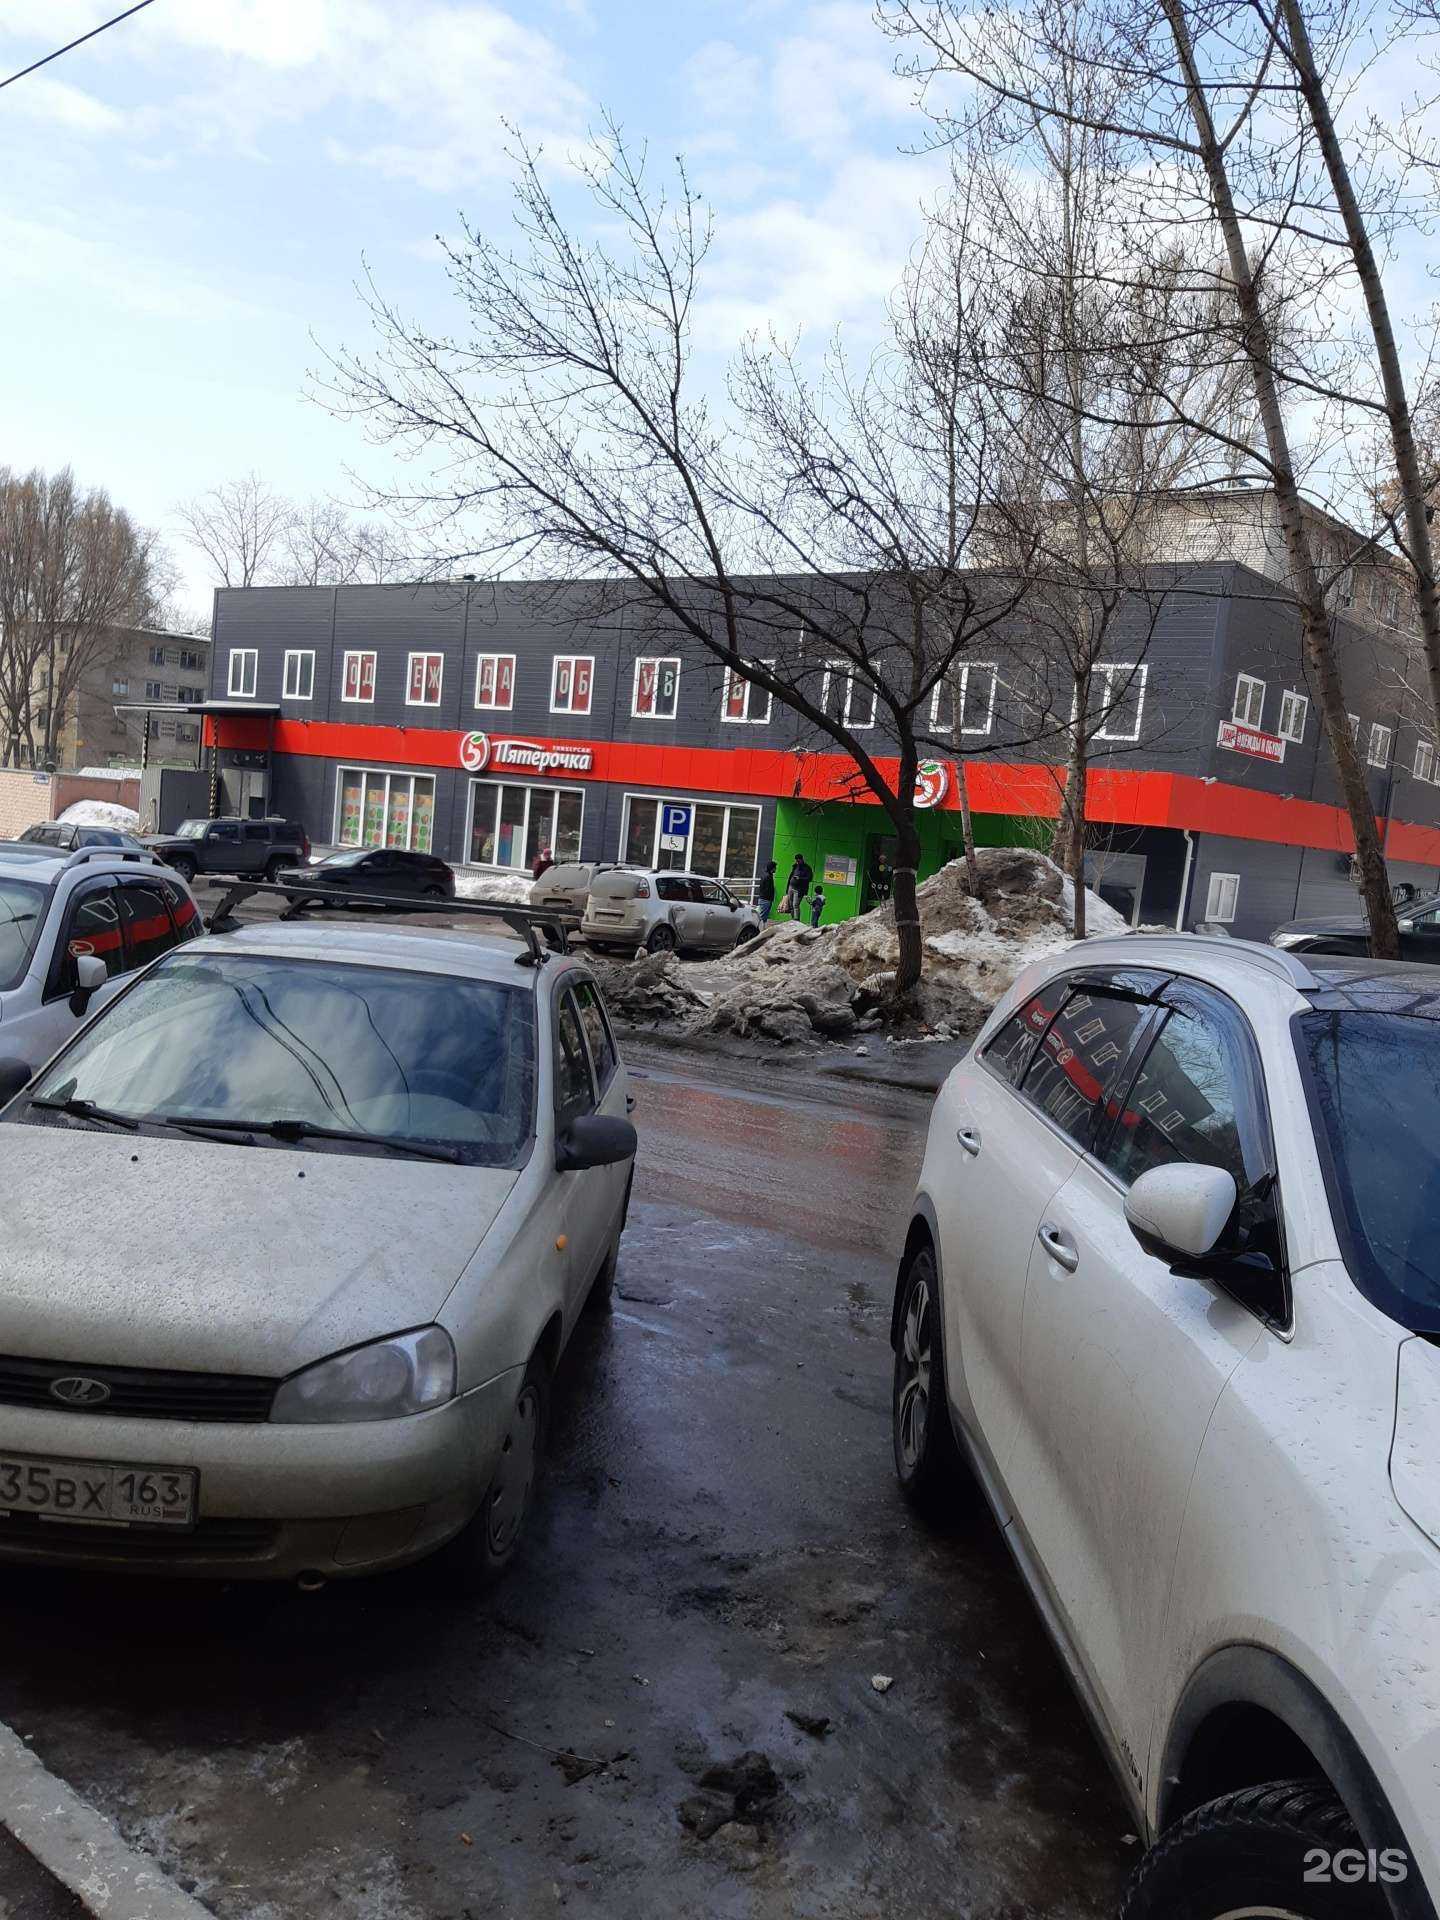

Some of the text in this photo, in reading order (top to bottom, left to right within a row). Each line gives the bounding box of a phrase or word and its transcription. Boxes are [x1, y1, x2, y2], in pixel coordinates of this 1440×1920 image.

[350, 661, 511, 692] ОДЕЖДА
[492, 740, 591, 771] Пятерочка
[118, 1473, 181, 1506] 163
[129, 1506, 162, 1518] RUS
